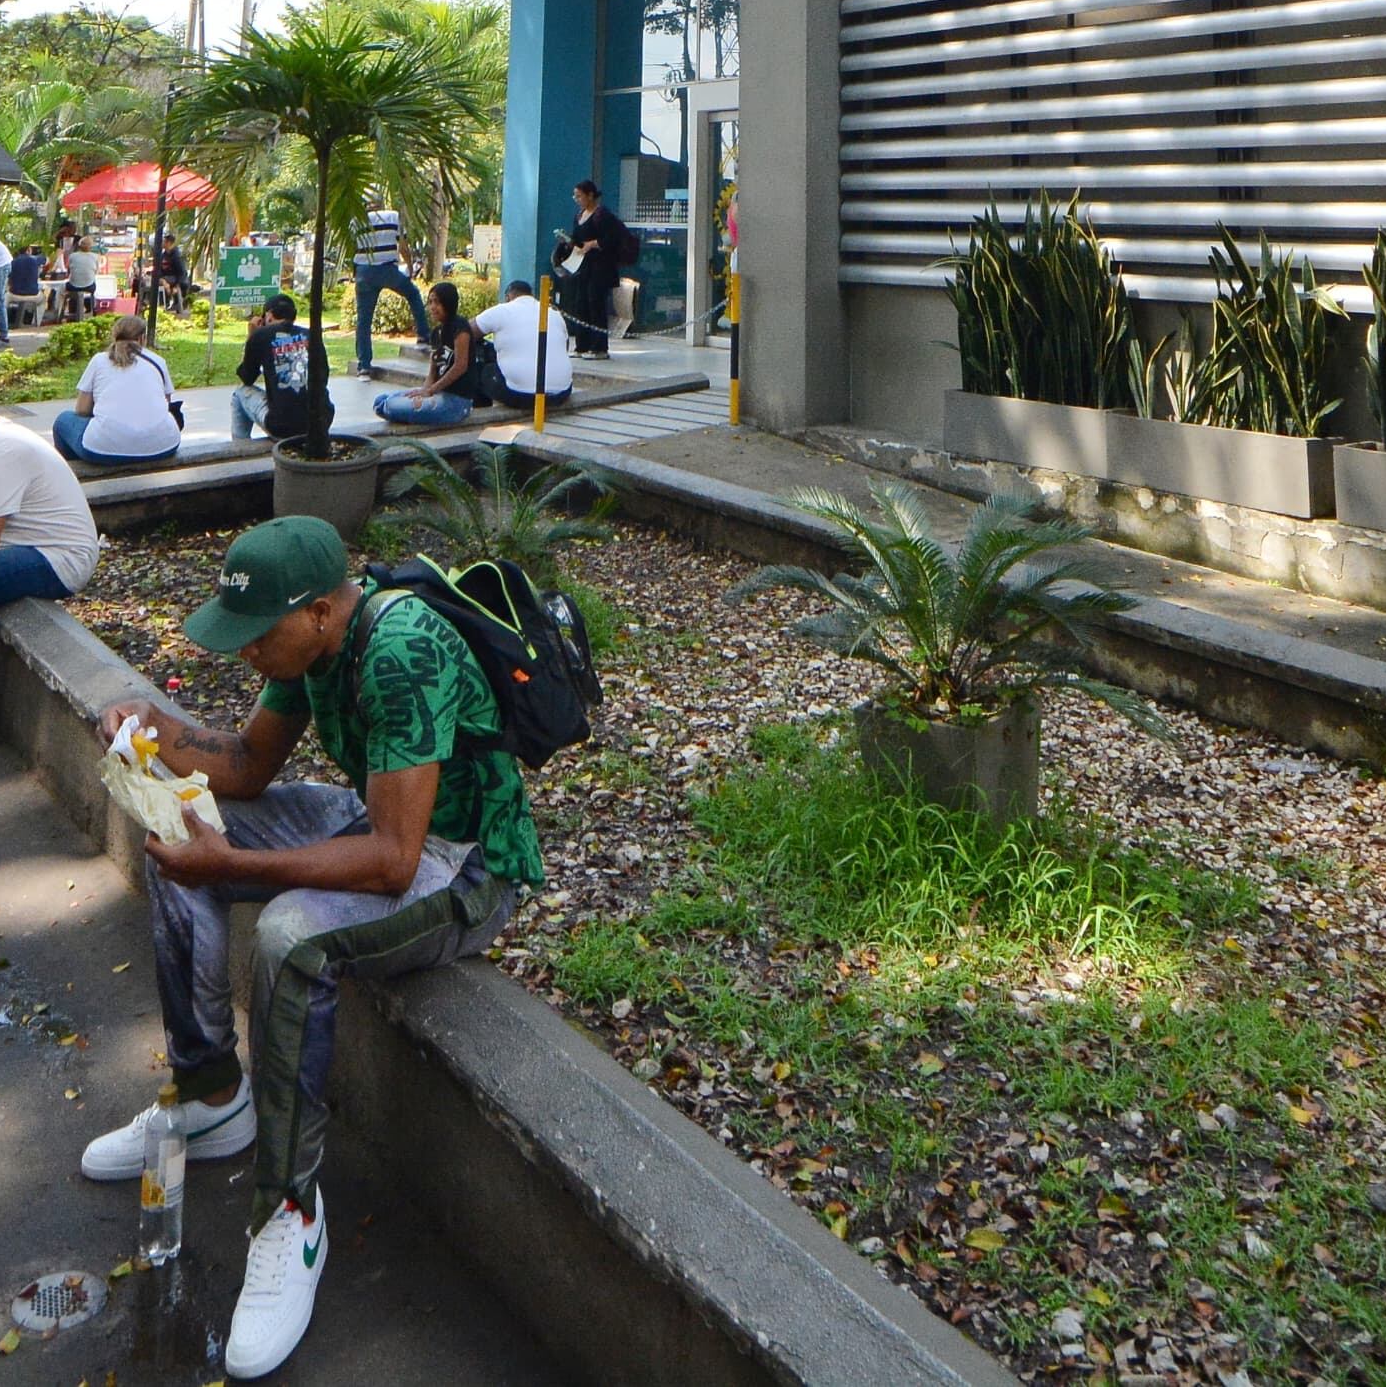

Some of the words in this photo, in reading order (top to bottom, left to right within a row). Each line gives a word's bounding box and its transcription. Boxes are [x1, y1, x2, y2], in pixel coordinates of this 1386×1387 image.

[231, 288, 252, 296] PUNTO
[253, 287, 262, 295] DE
[229, 296, 266, 304] ENCUENTRO
